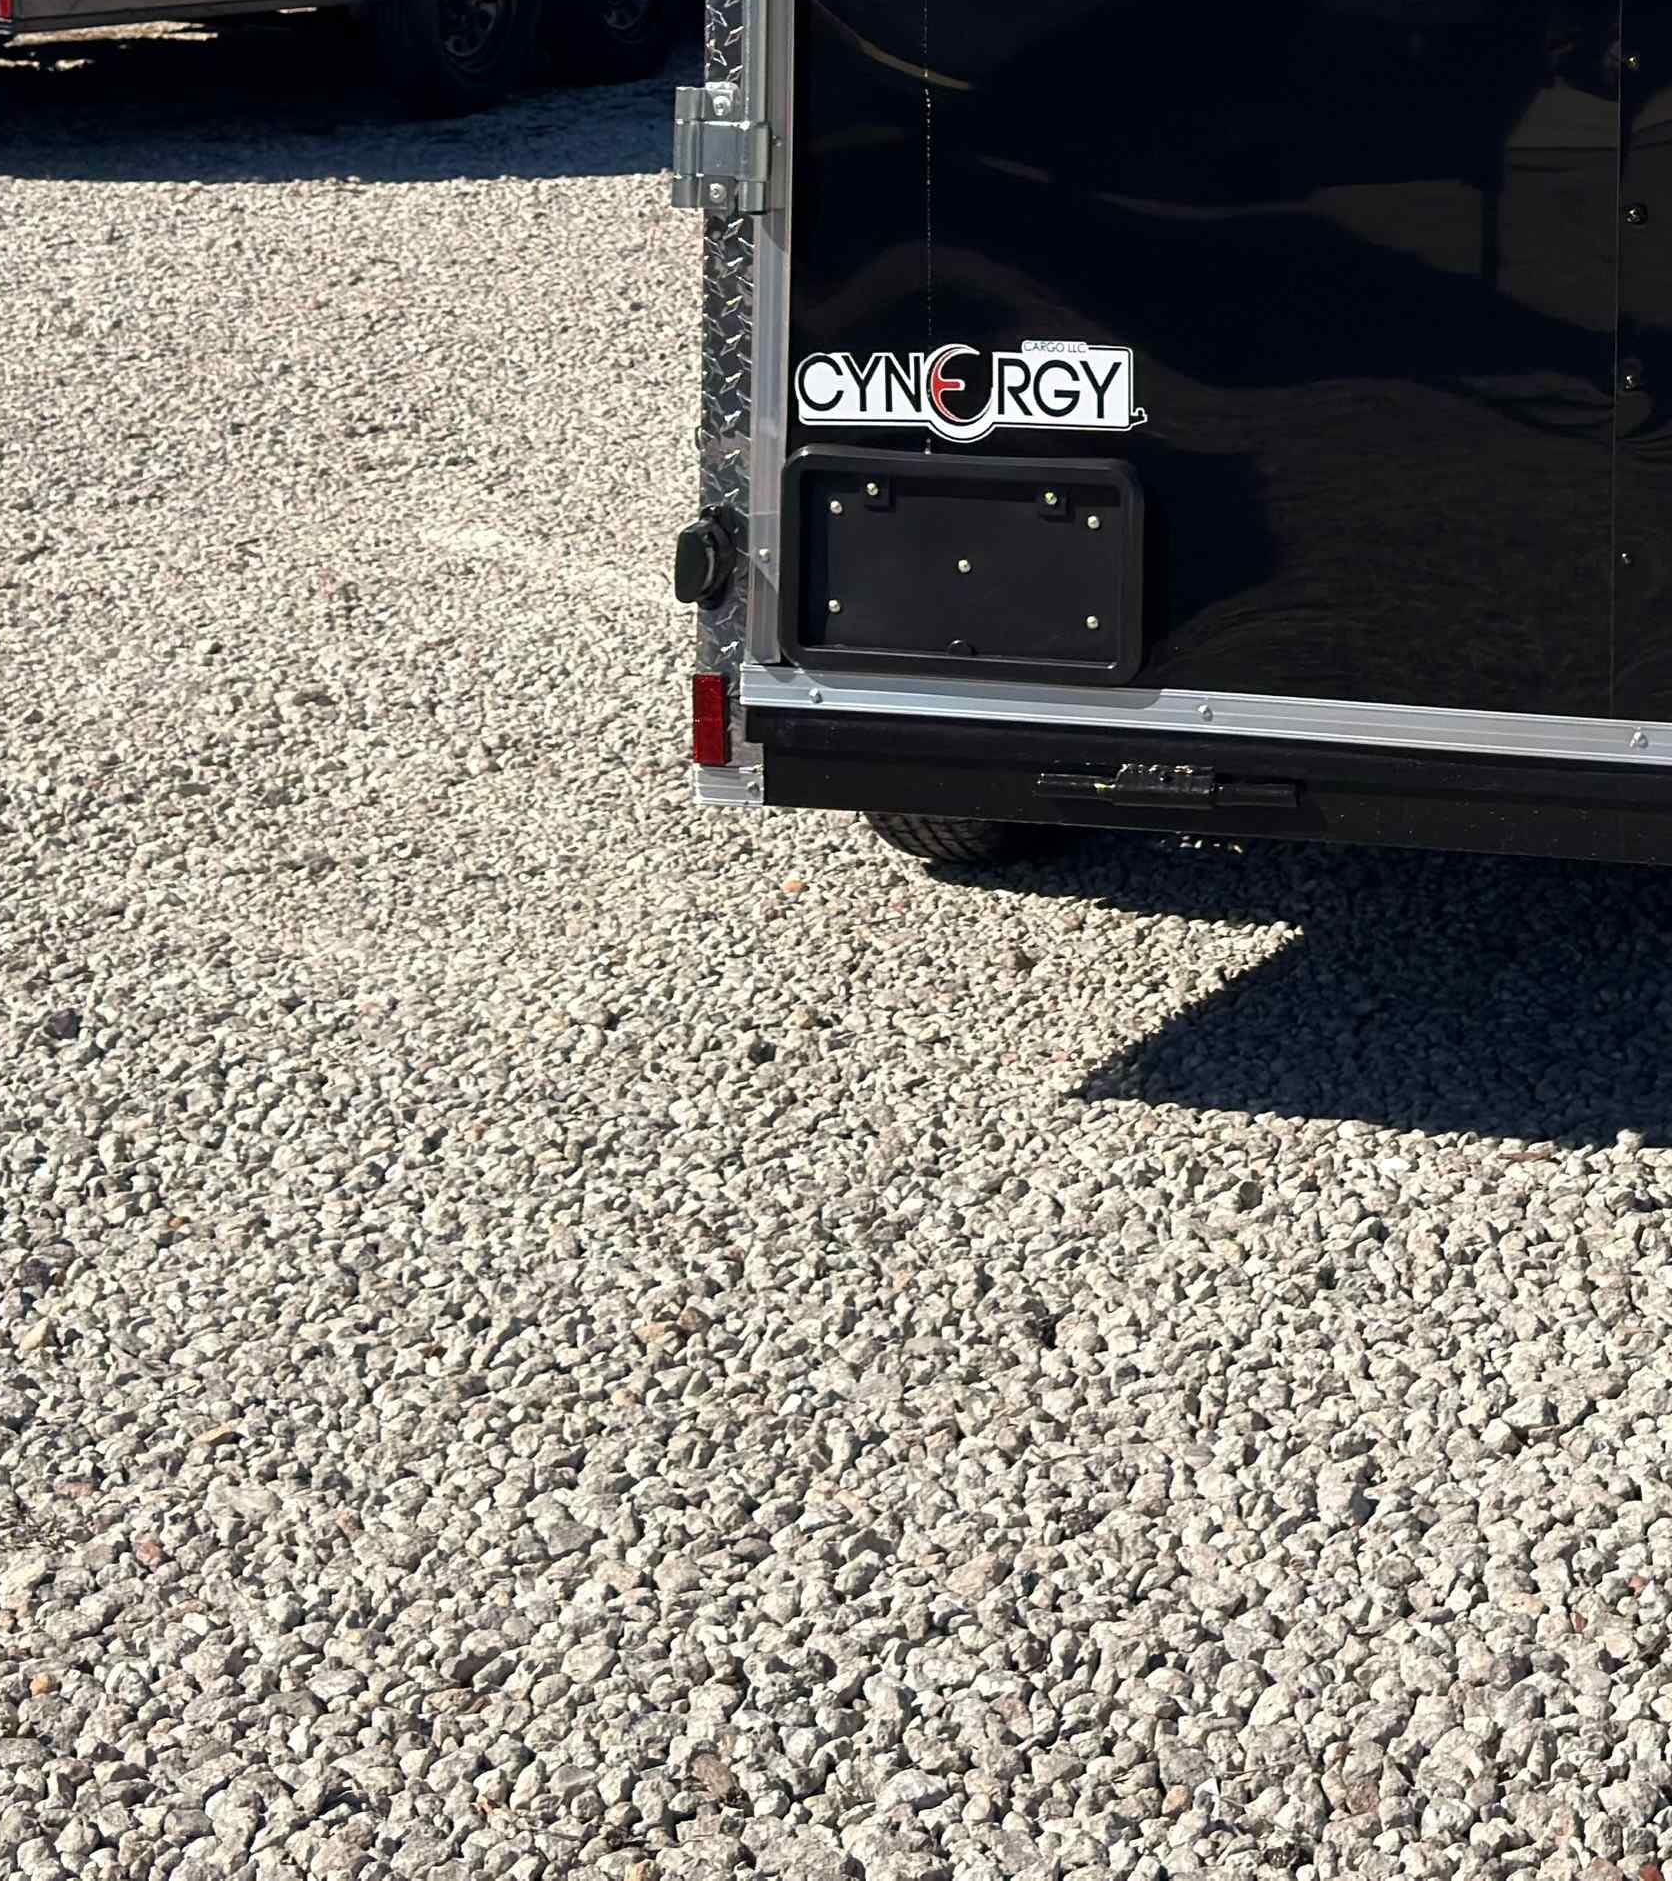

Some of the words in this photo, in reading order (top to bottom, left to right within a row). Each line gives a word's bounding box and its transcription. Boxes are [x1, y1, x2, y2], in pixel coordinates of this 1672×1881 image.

[1024, 341, 1065, 353] CARGO
[1067, 342, 1086, 353] LLC
[797, 347, 1123, 426] CYNERGY
